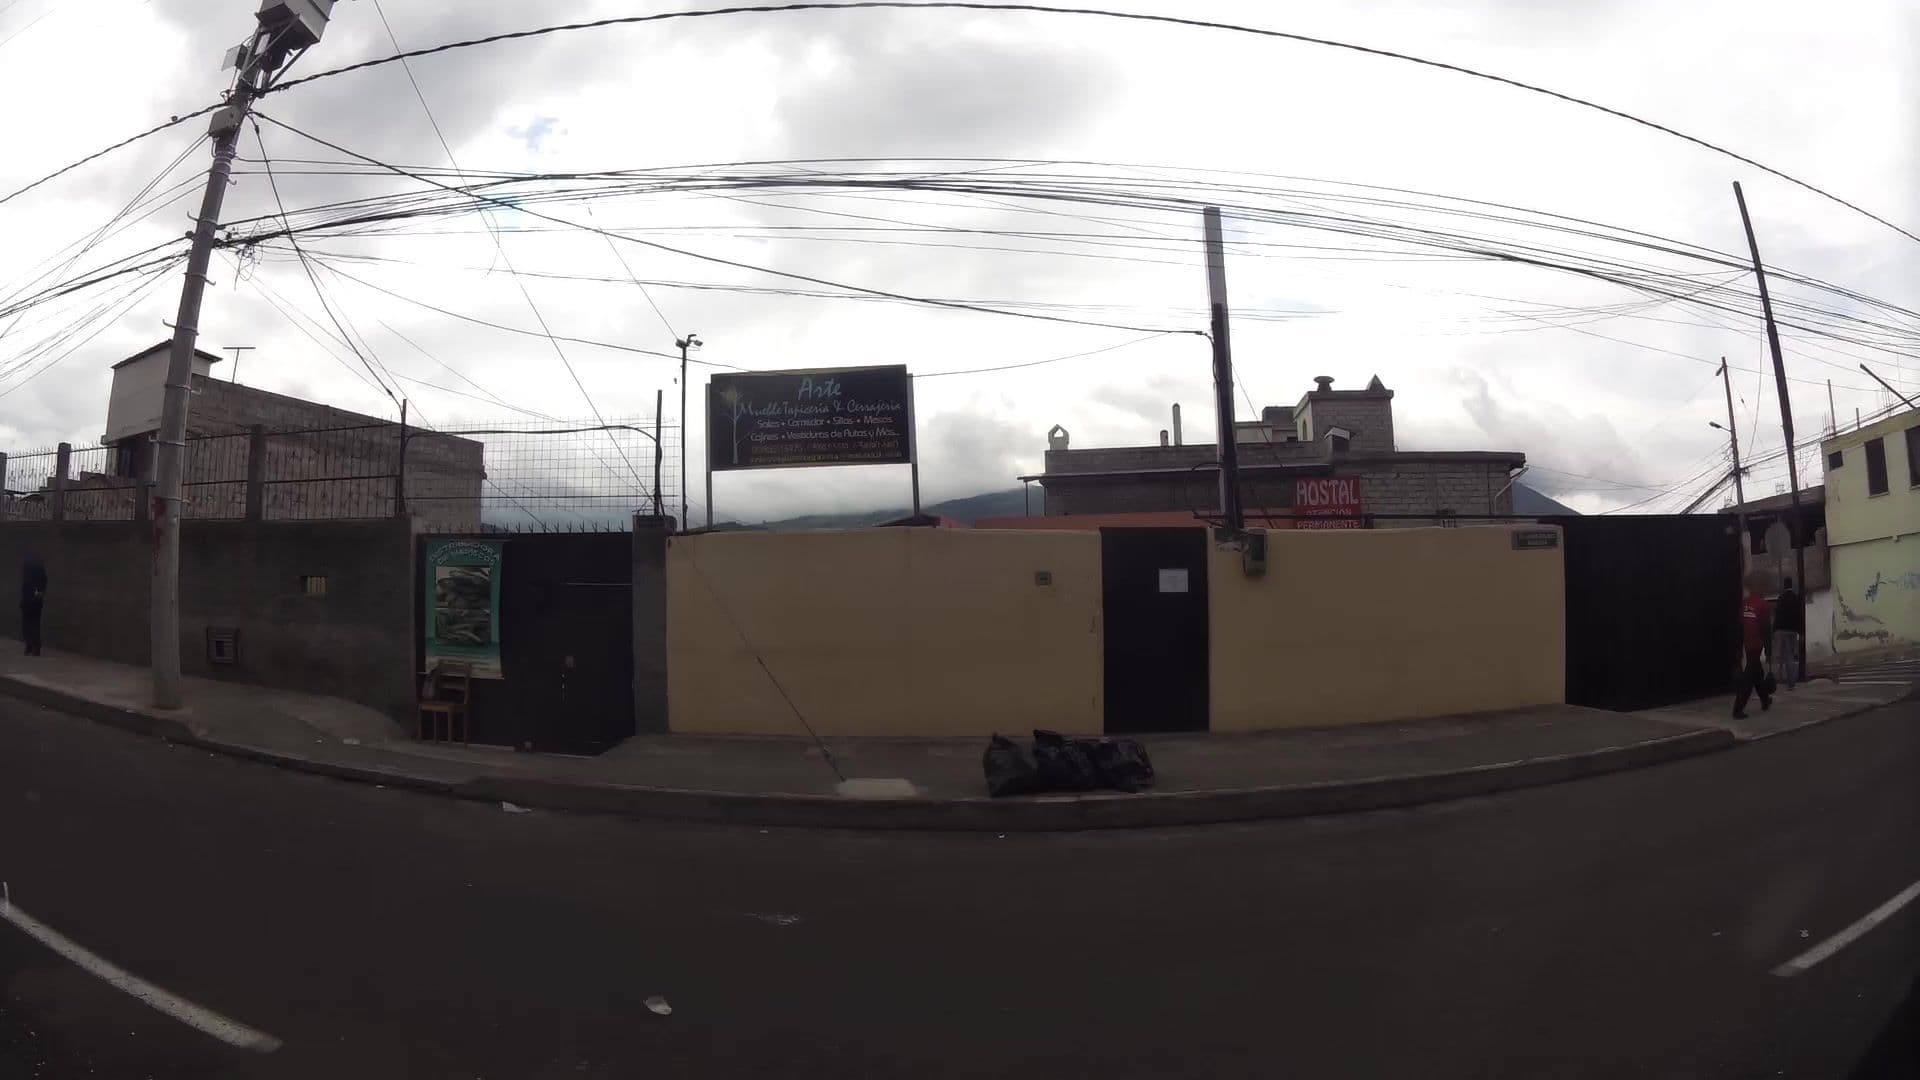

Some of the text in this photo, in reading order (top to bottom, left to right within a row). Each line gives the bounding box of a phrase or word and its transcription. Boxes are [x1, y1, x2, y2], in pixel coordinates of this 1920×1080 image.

[798, 377, 842, 400] Arte
[830, 429, 843, 438] de
[843, 428, 868, 438] Autos
[1296, 480, 1360, 506] HOSTAL
